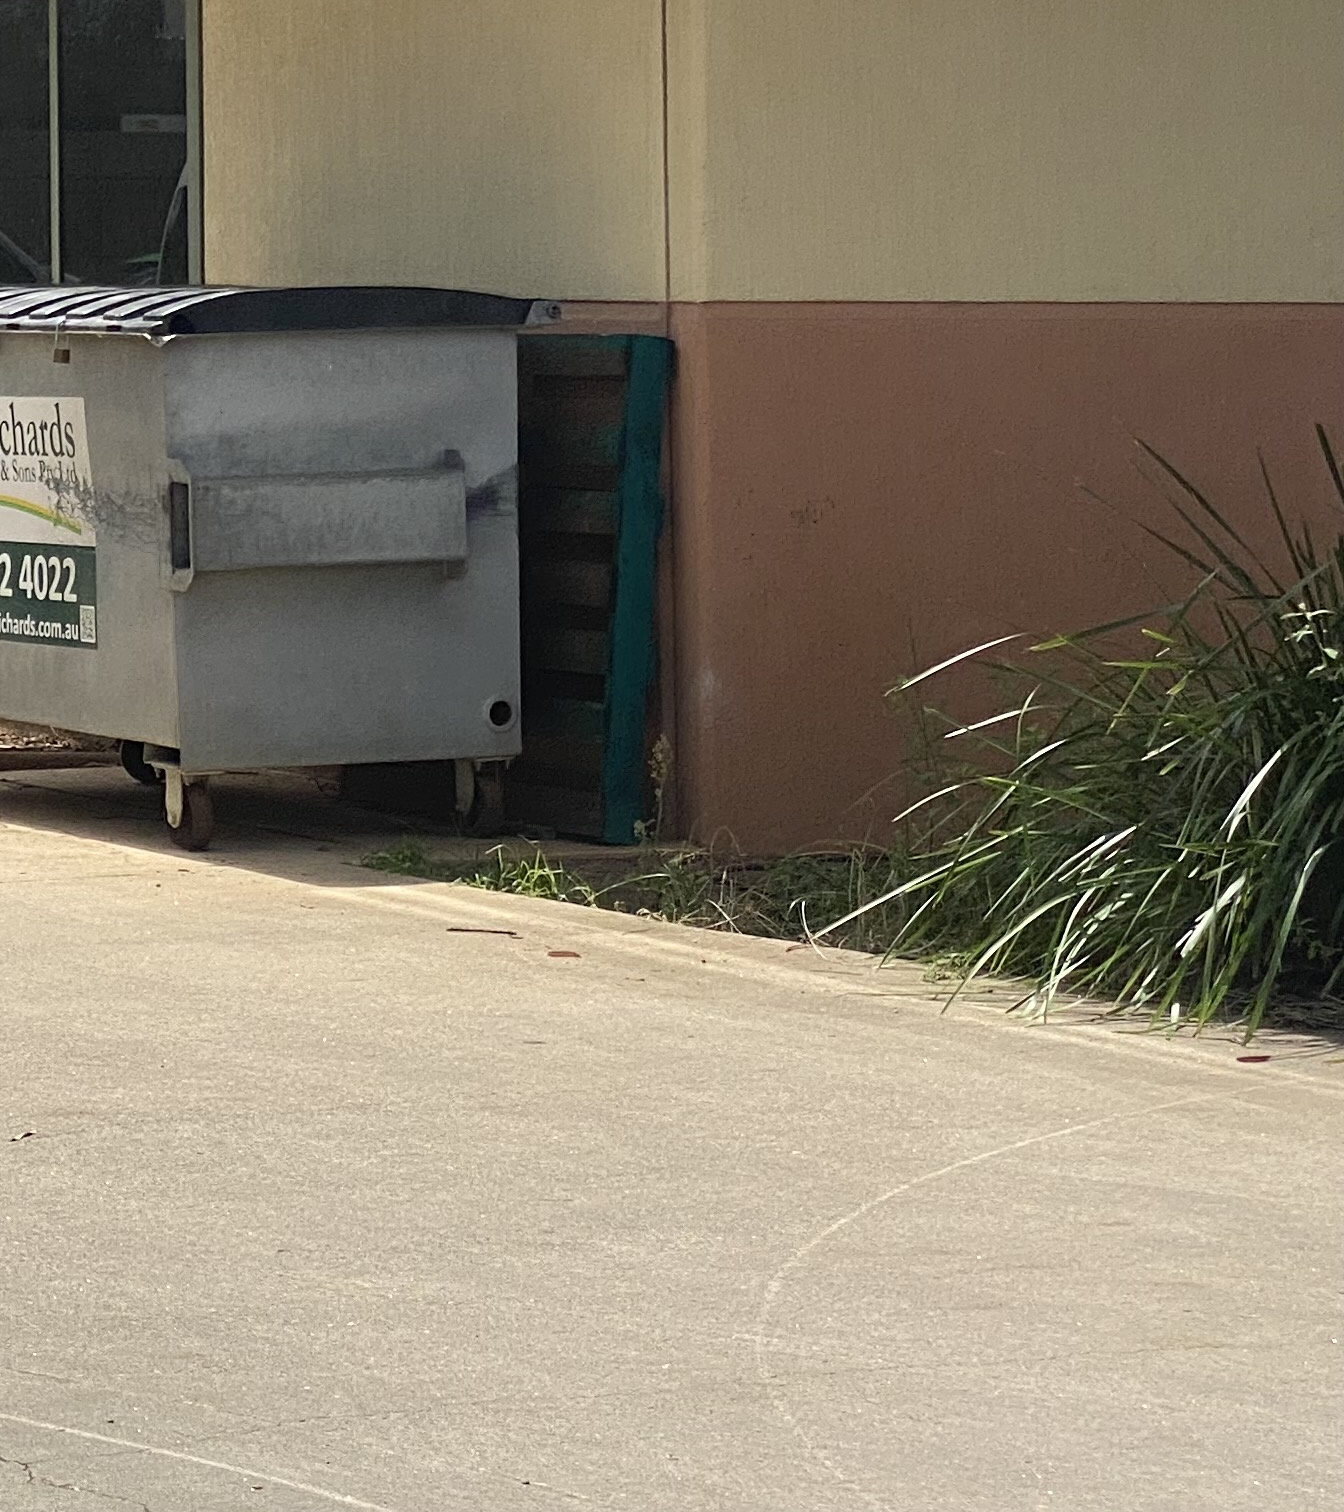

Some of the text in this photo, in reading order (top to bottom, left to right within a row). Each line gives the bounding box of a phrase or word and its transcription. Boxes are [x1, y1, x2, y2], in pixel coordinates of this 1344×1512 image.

[0, 459, 10, 482] &
[12, 459, 37, 483] Sons
[18, 554, 78, 603] 4022
